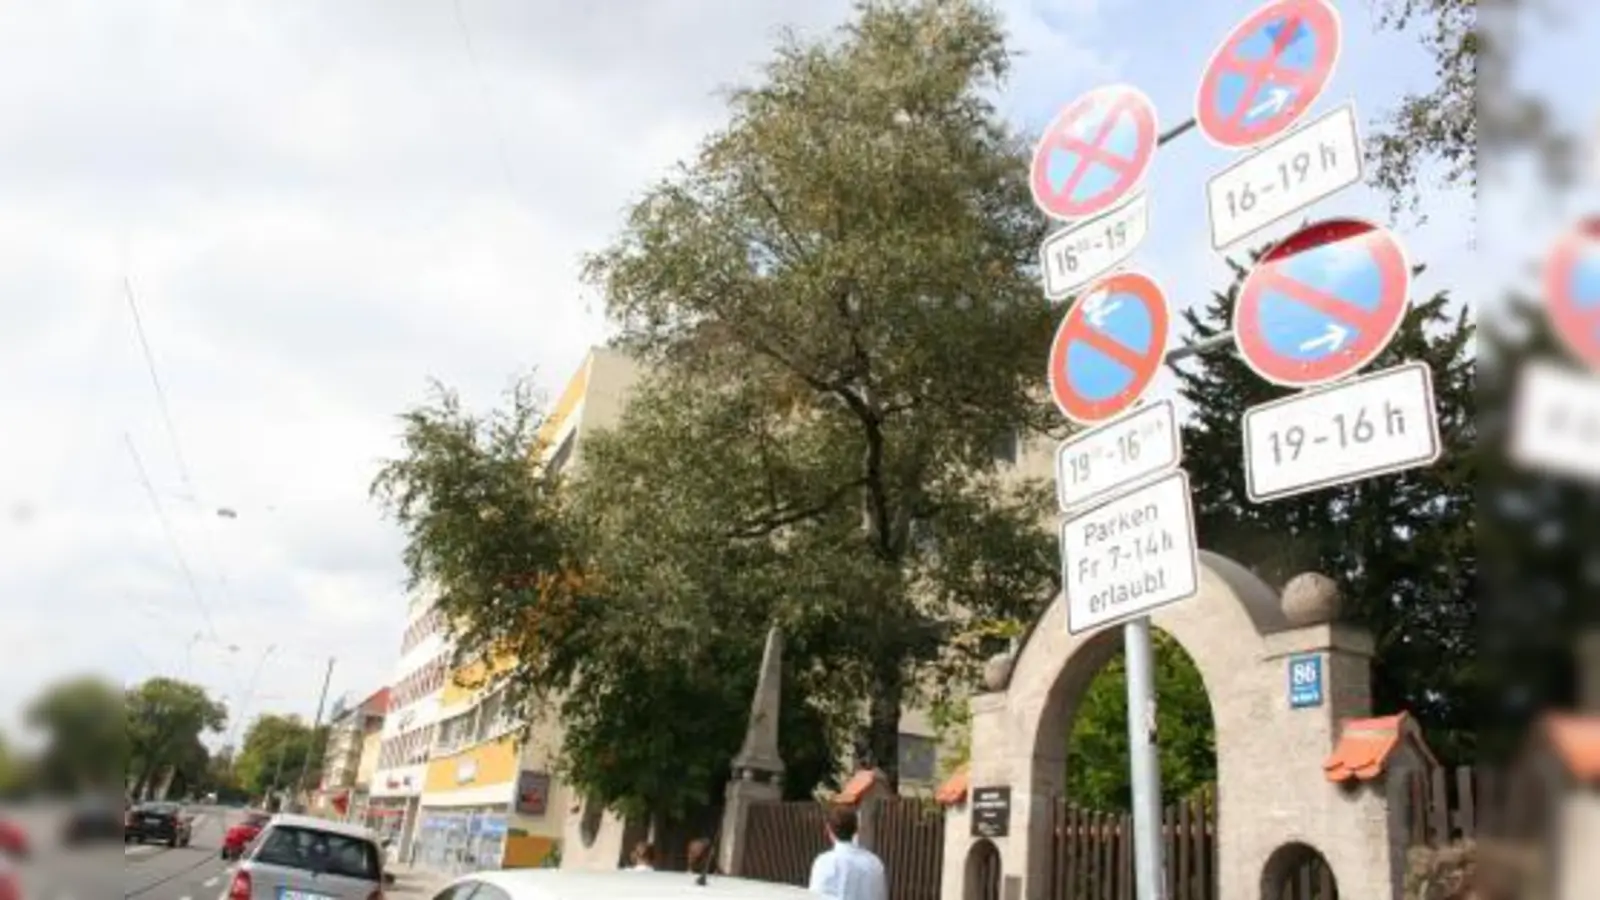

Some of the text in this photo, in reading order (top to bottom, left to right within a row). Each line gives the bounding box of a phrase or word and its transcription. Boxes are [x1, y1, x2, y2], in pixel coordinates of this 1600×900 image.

[1319, 142, 1337, 172] h
[1384, 398, 1406, 437] h
[1083, 503, 1159, 547] Parken
[1078, 556, 1100, 584] Fr
[1089, 567, 1166, 614] erlaubt
[1293, 660, 1316, 685] 86
